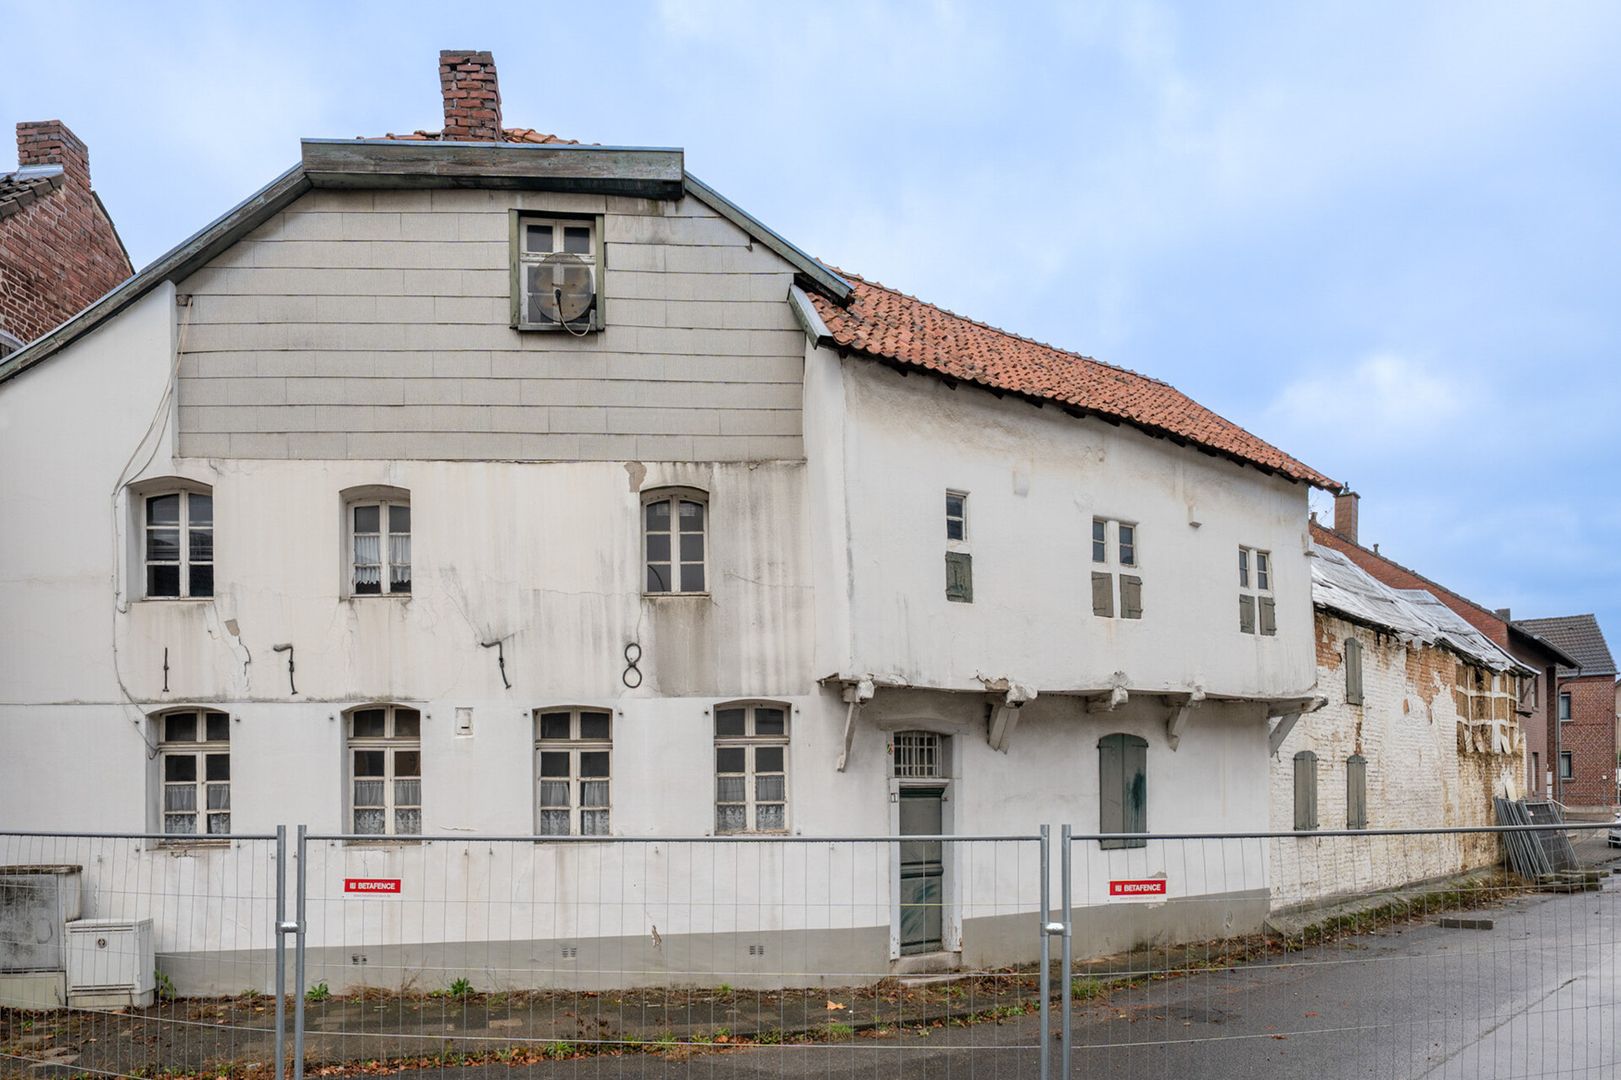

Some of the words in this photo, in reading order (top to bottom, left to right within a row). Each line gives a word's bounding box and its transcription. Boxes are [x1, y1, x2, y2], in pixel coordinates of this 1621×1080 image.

[623, 643, 642, 689] 8
[358, 882, 396, 890] BETAFENCE
[1124, 883, 1162, 892] BETAFENCE
